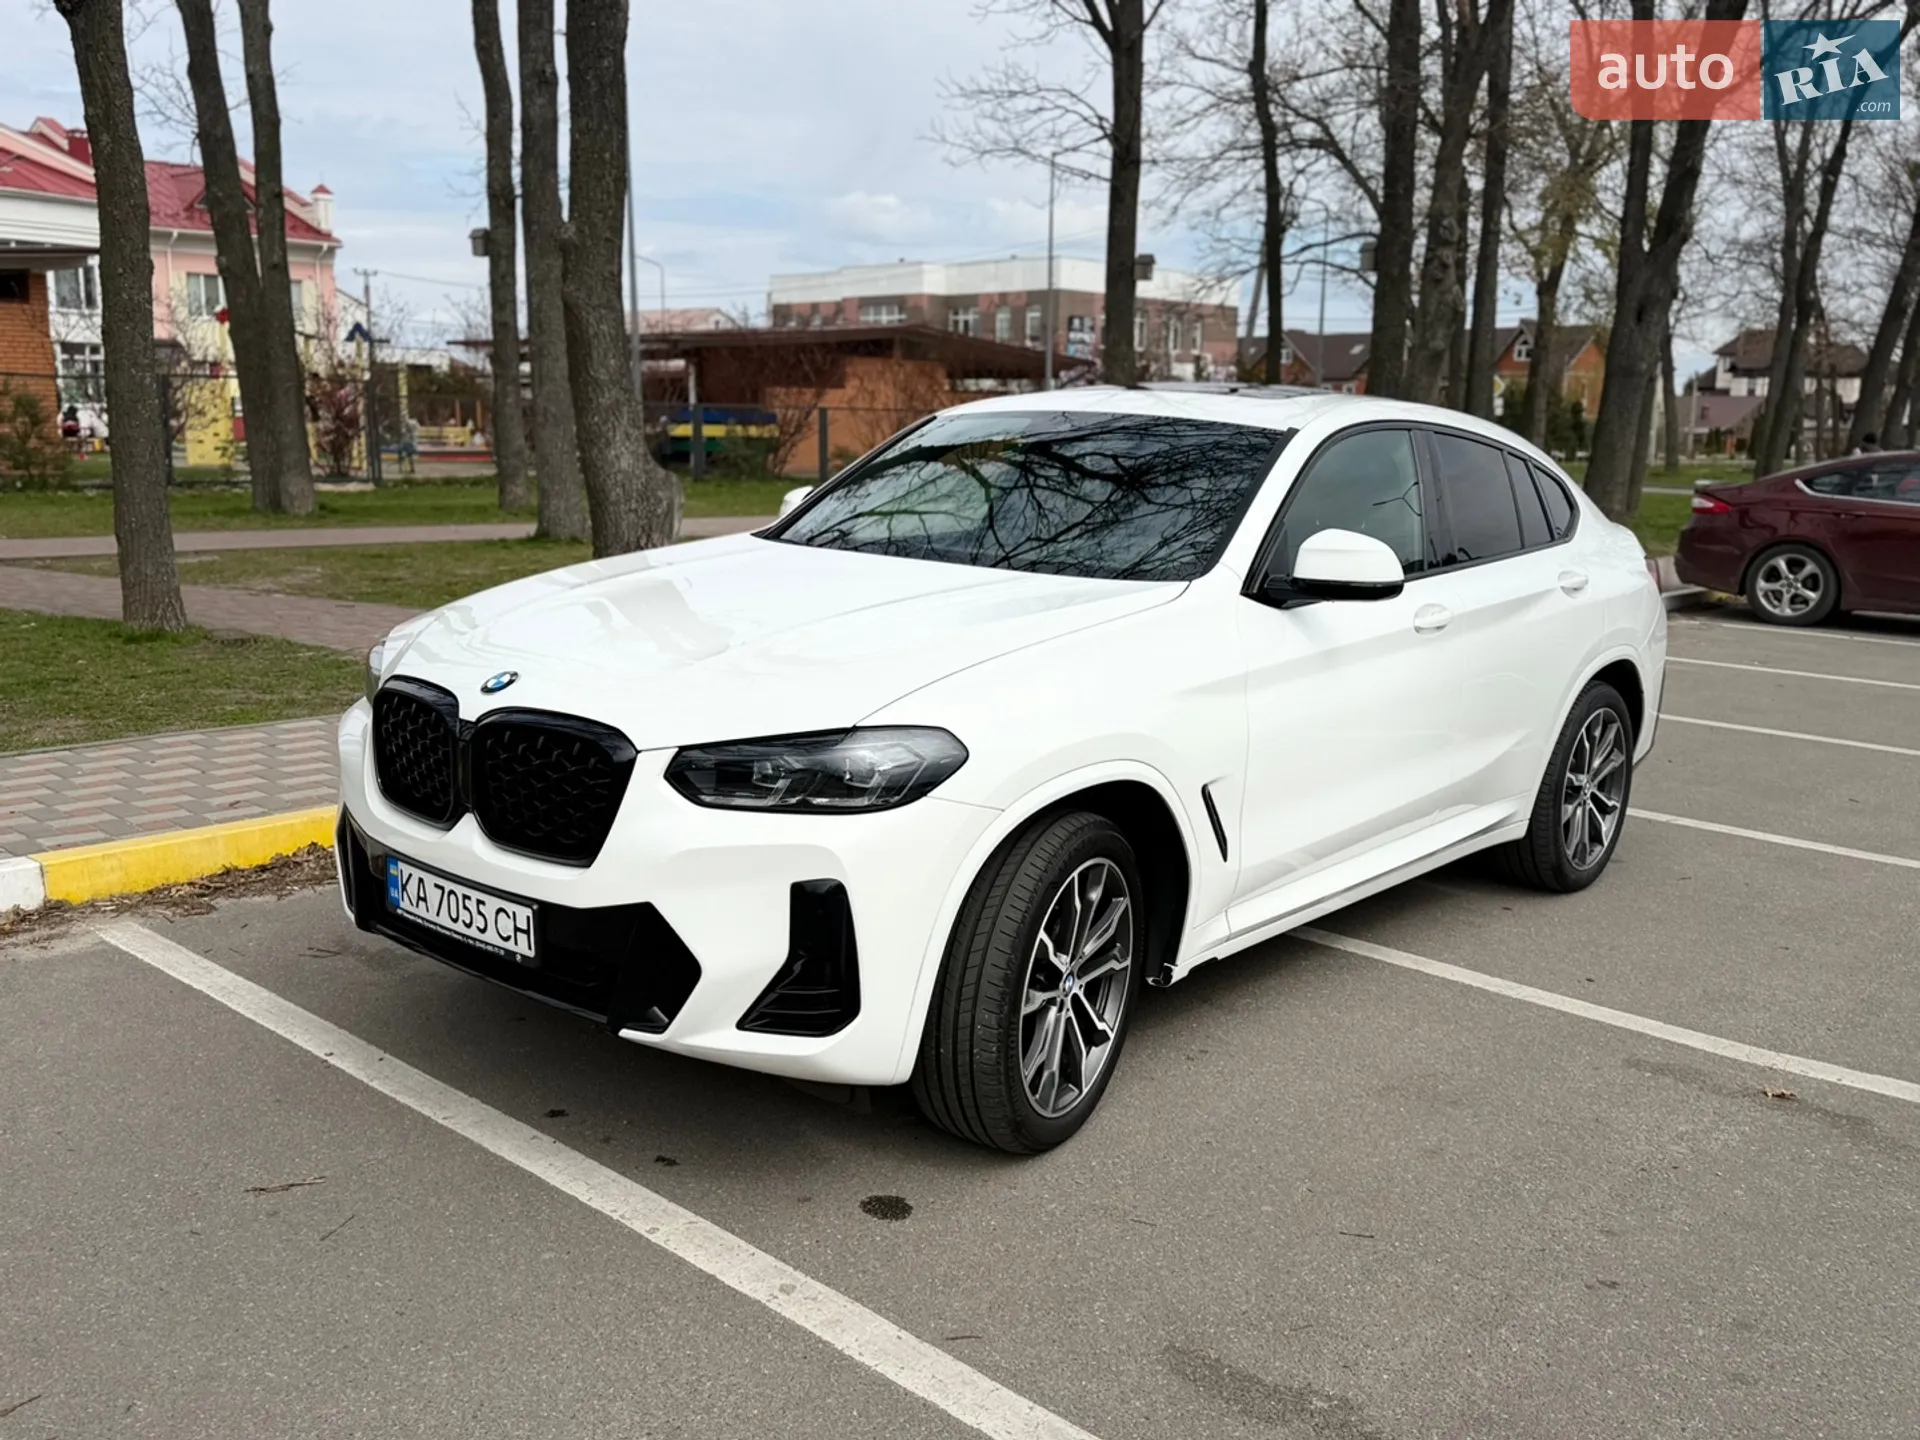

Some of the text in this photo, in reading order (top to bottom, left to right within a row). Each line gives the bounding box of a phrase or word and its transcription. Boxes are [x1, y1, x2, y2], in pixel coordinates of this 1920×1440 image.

[400, 868, 429, 914] KA
[433, 883, 488, 935] 7055
[495, 907, 532, 951] CH
